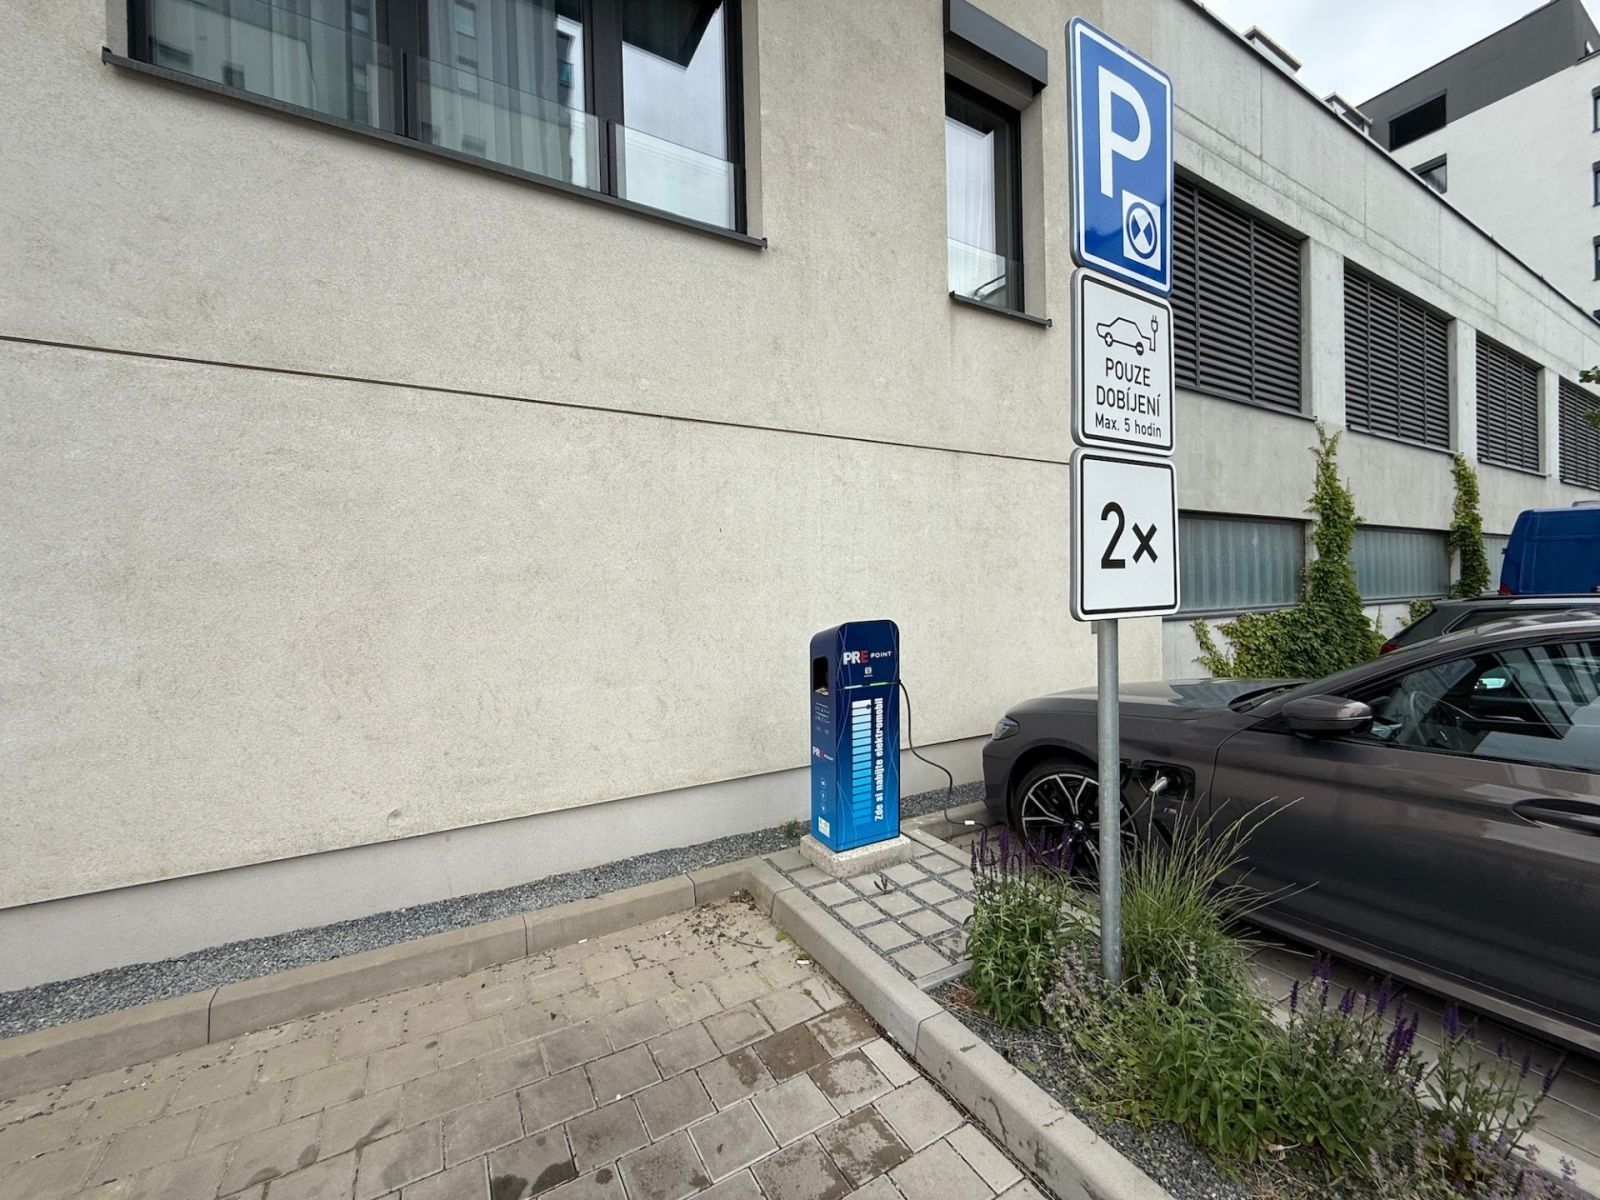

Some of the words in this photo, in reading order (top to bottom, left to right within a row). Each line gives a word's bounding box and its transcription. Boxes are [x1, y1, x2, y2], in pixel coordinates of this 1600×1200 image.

[1098, 64, 1152, 199] P
[1105, 357, 1151, 387] POUZE
[1096, 385, 1161, 417] DOBÍJENÍ
[1095, 412, 1120, 431] Max.
[1124, 417, 1130, 433] 5
[1134, 419, 1162, 438] hodin
[842, 650, 868, 665] PRE
[874, 697, 884, 757] elektromobil
[874, 792, 884, 802] si
[874, 803, 884, 821] Zde
